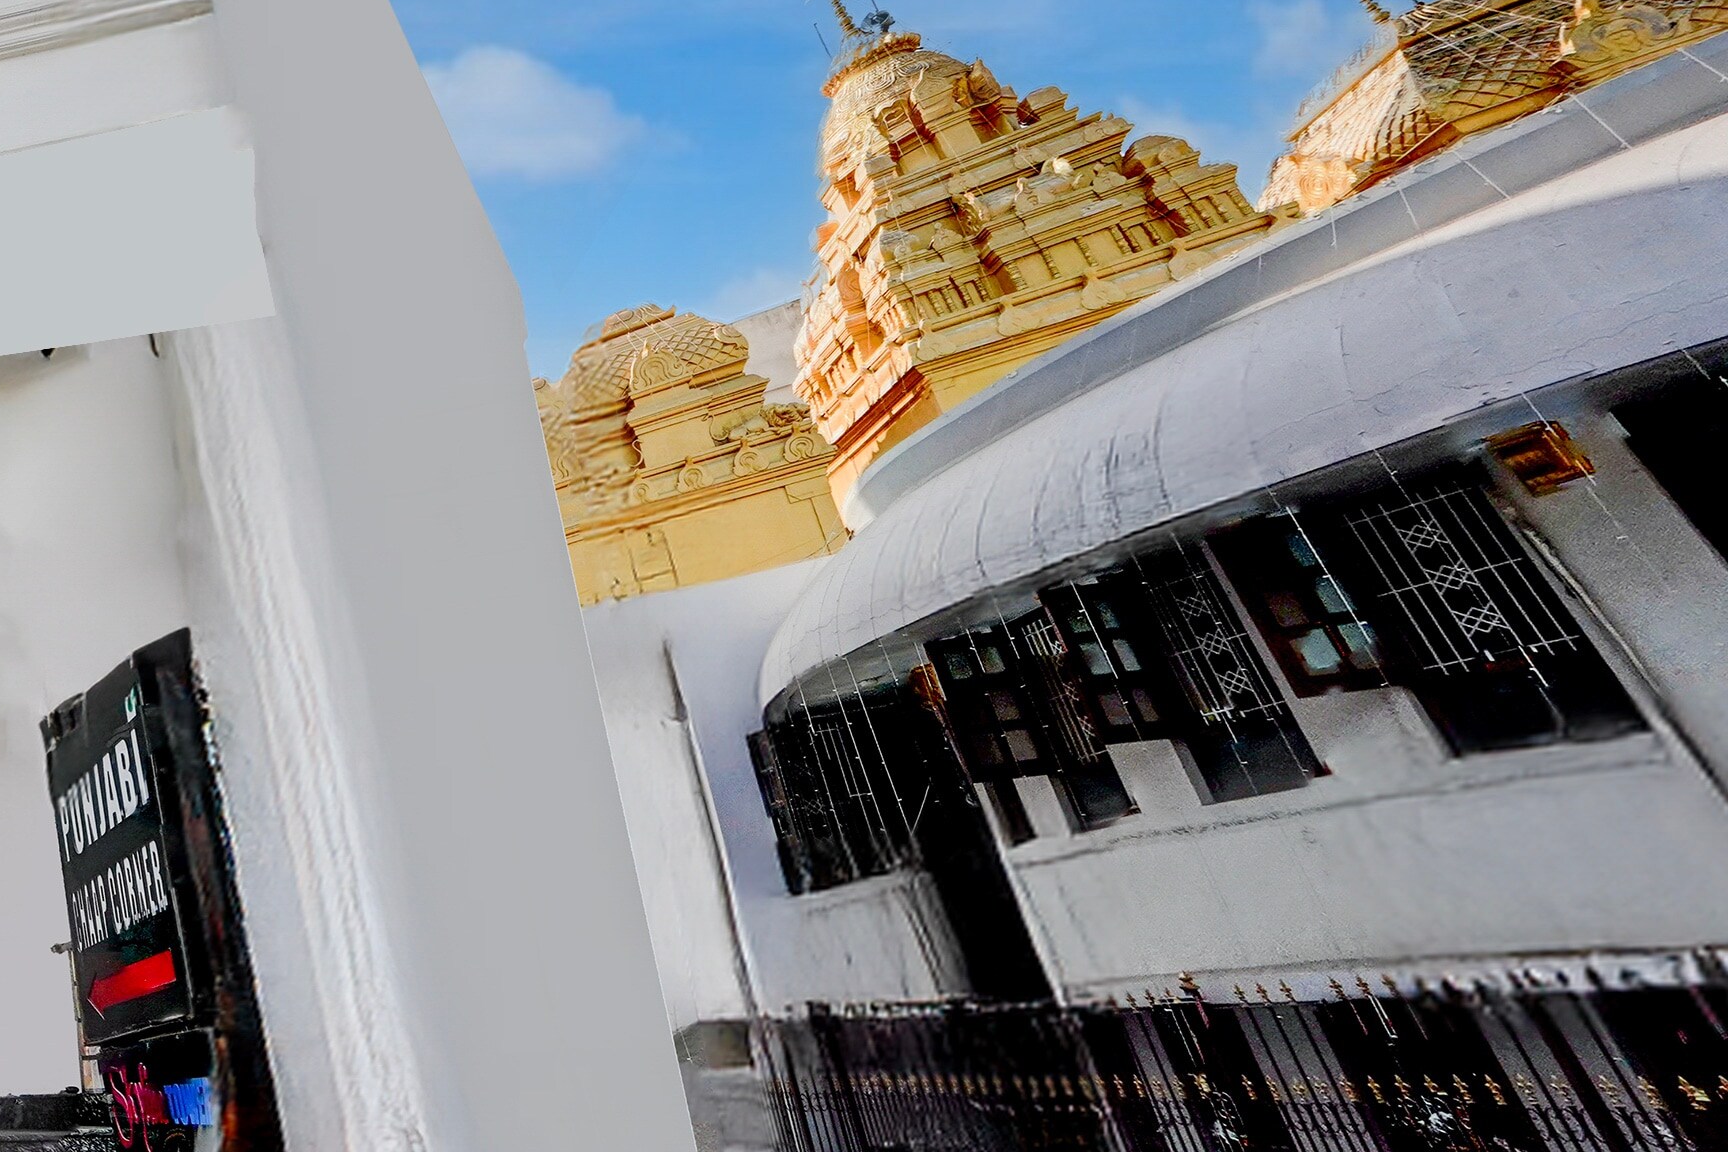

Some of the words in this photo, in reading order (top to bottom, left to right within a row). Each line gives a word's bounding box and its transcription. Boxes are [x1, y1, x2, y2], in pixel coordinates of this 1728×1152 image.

[59, 728, 150, 862] PUNJABI
[72, 874, 109, 953] CHAAP
[107, 840, 168, 935] CORNER
